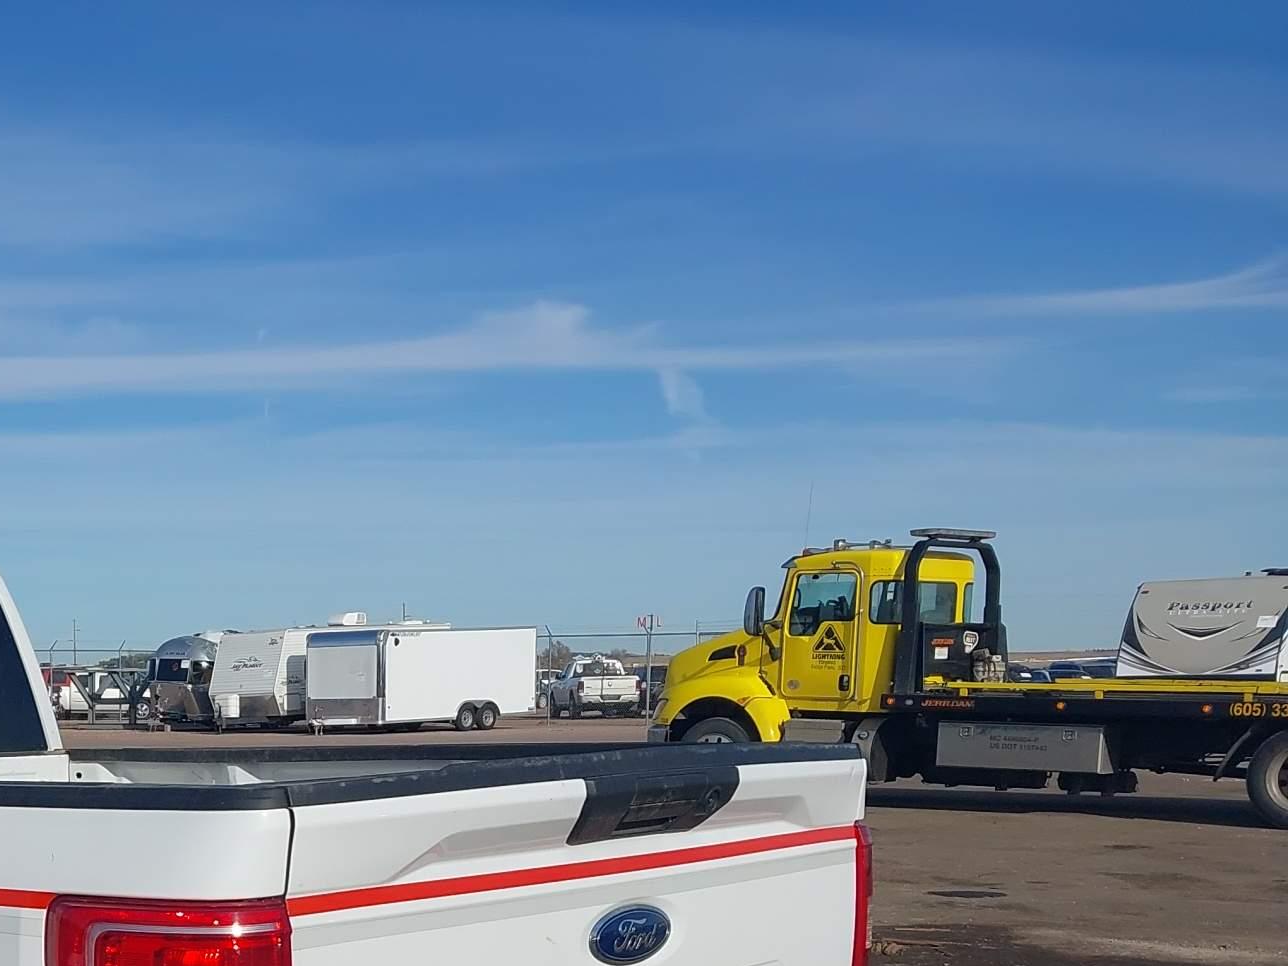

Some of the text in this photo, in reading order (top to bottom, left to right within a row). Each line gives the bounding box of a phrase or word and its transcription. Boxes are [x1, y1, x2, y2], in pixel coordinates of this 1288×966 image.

[1167, 599, 1254, 611] Passport
[637, 616, 647, 628] M
[1229, 702, 1267, 717] (605)
[613, 918, 658, 953] Ford
